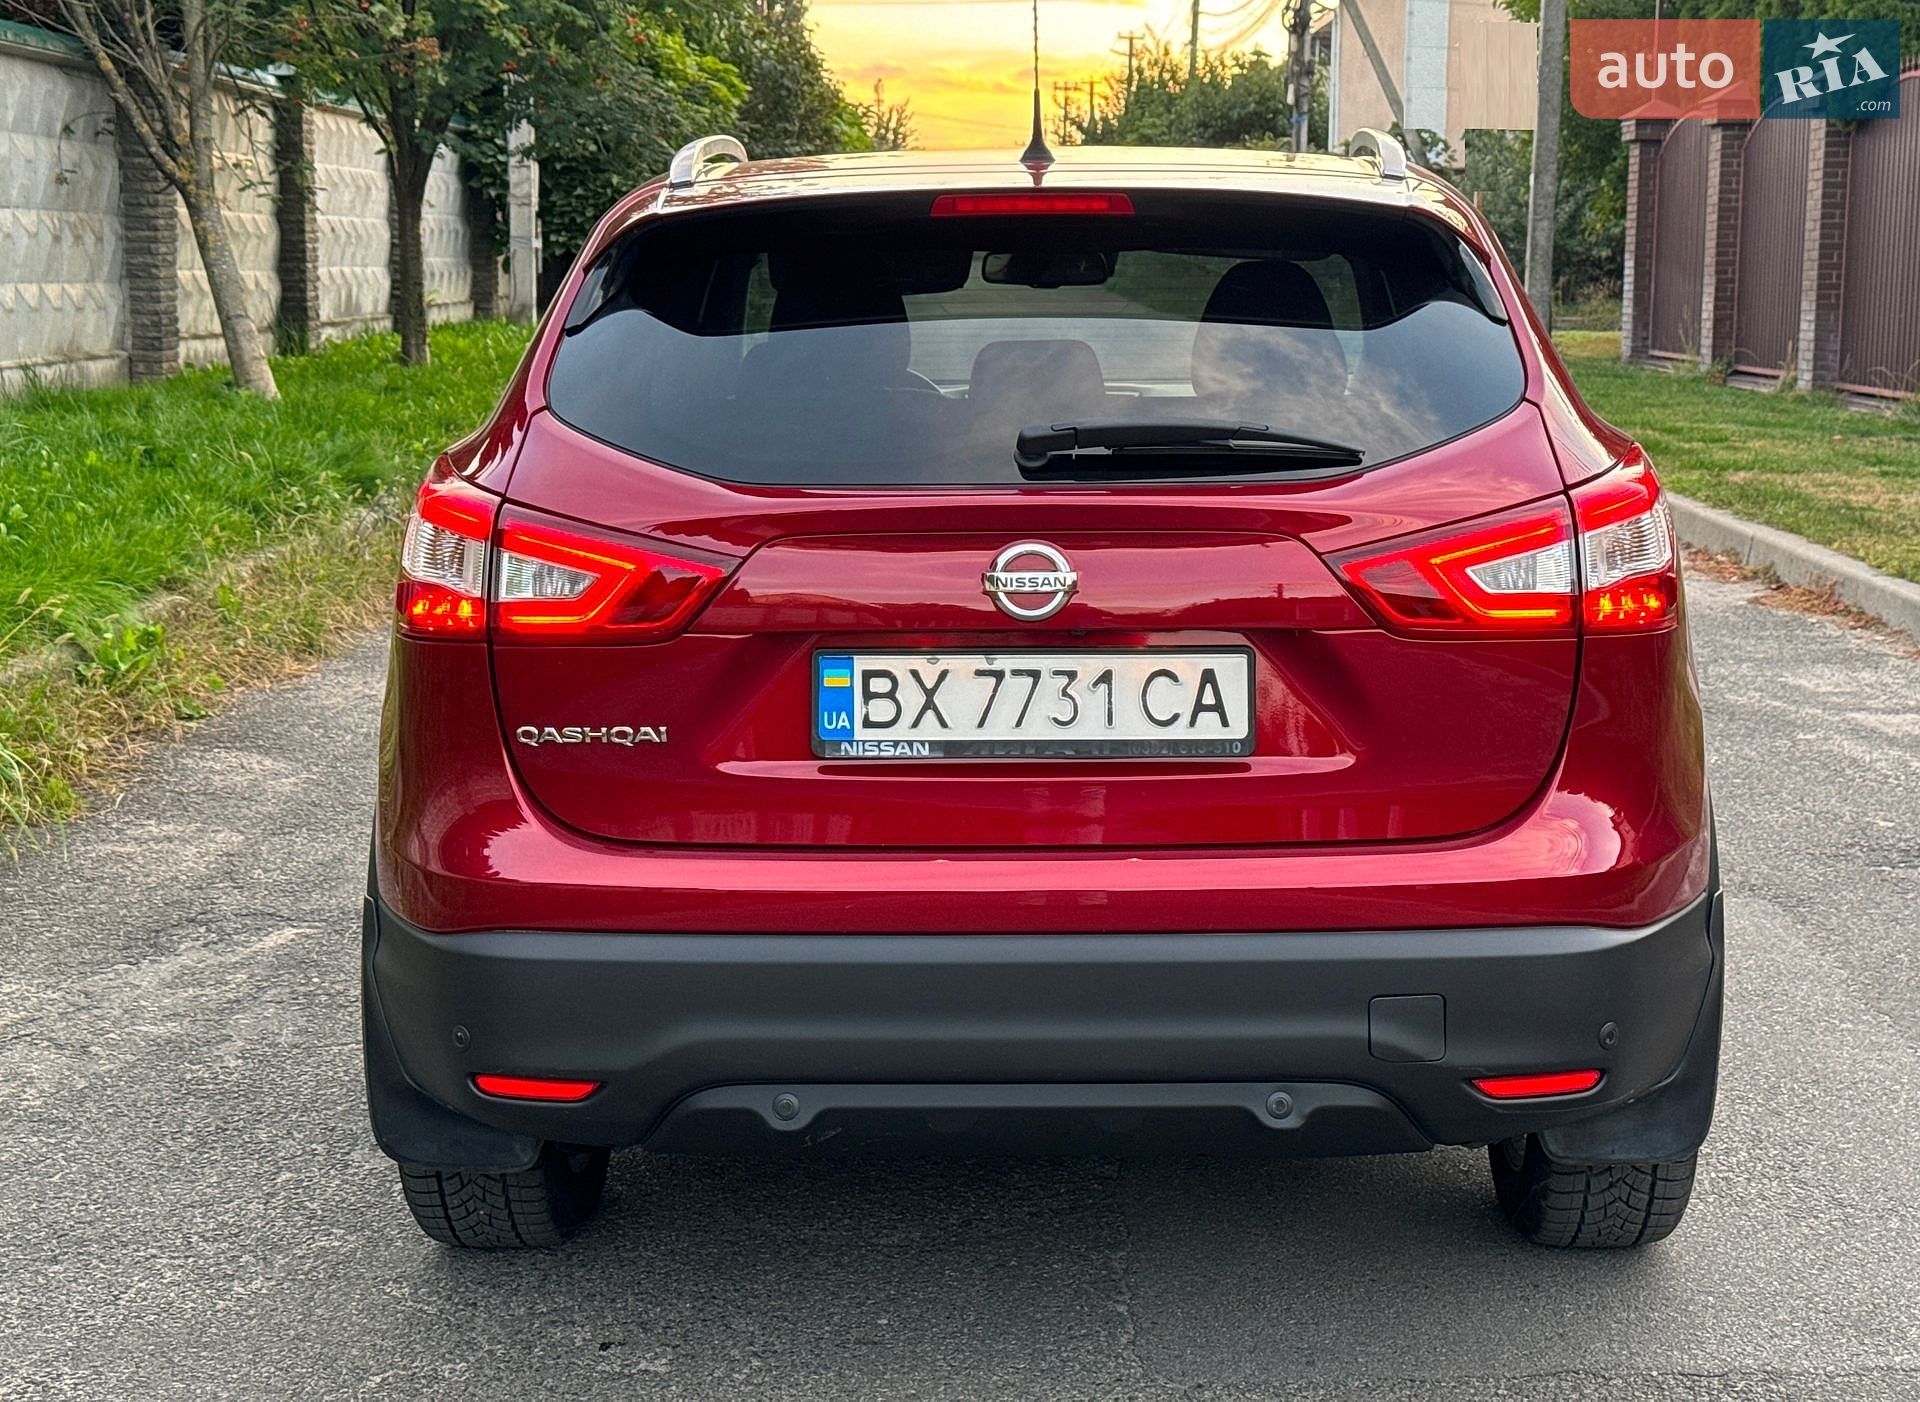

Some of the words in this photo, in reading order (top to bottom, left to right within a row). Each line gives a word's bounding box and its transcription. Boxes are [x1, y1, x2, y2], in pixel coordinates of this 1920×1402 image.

[996, 576, 1067, 588] NISSAN
[861, 667, 951, 730] BX
[974, 668, 1114, 729] 7731
[1141, 668, 1231, 728] CA
[823, 712, 850, 730] UA
[516, 726, 668, 747] QASHQAI
[840, 741, 930, 756] NISSAN
